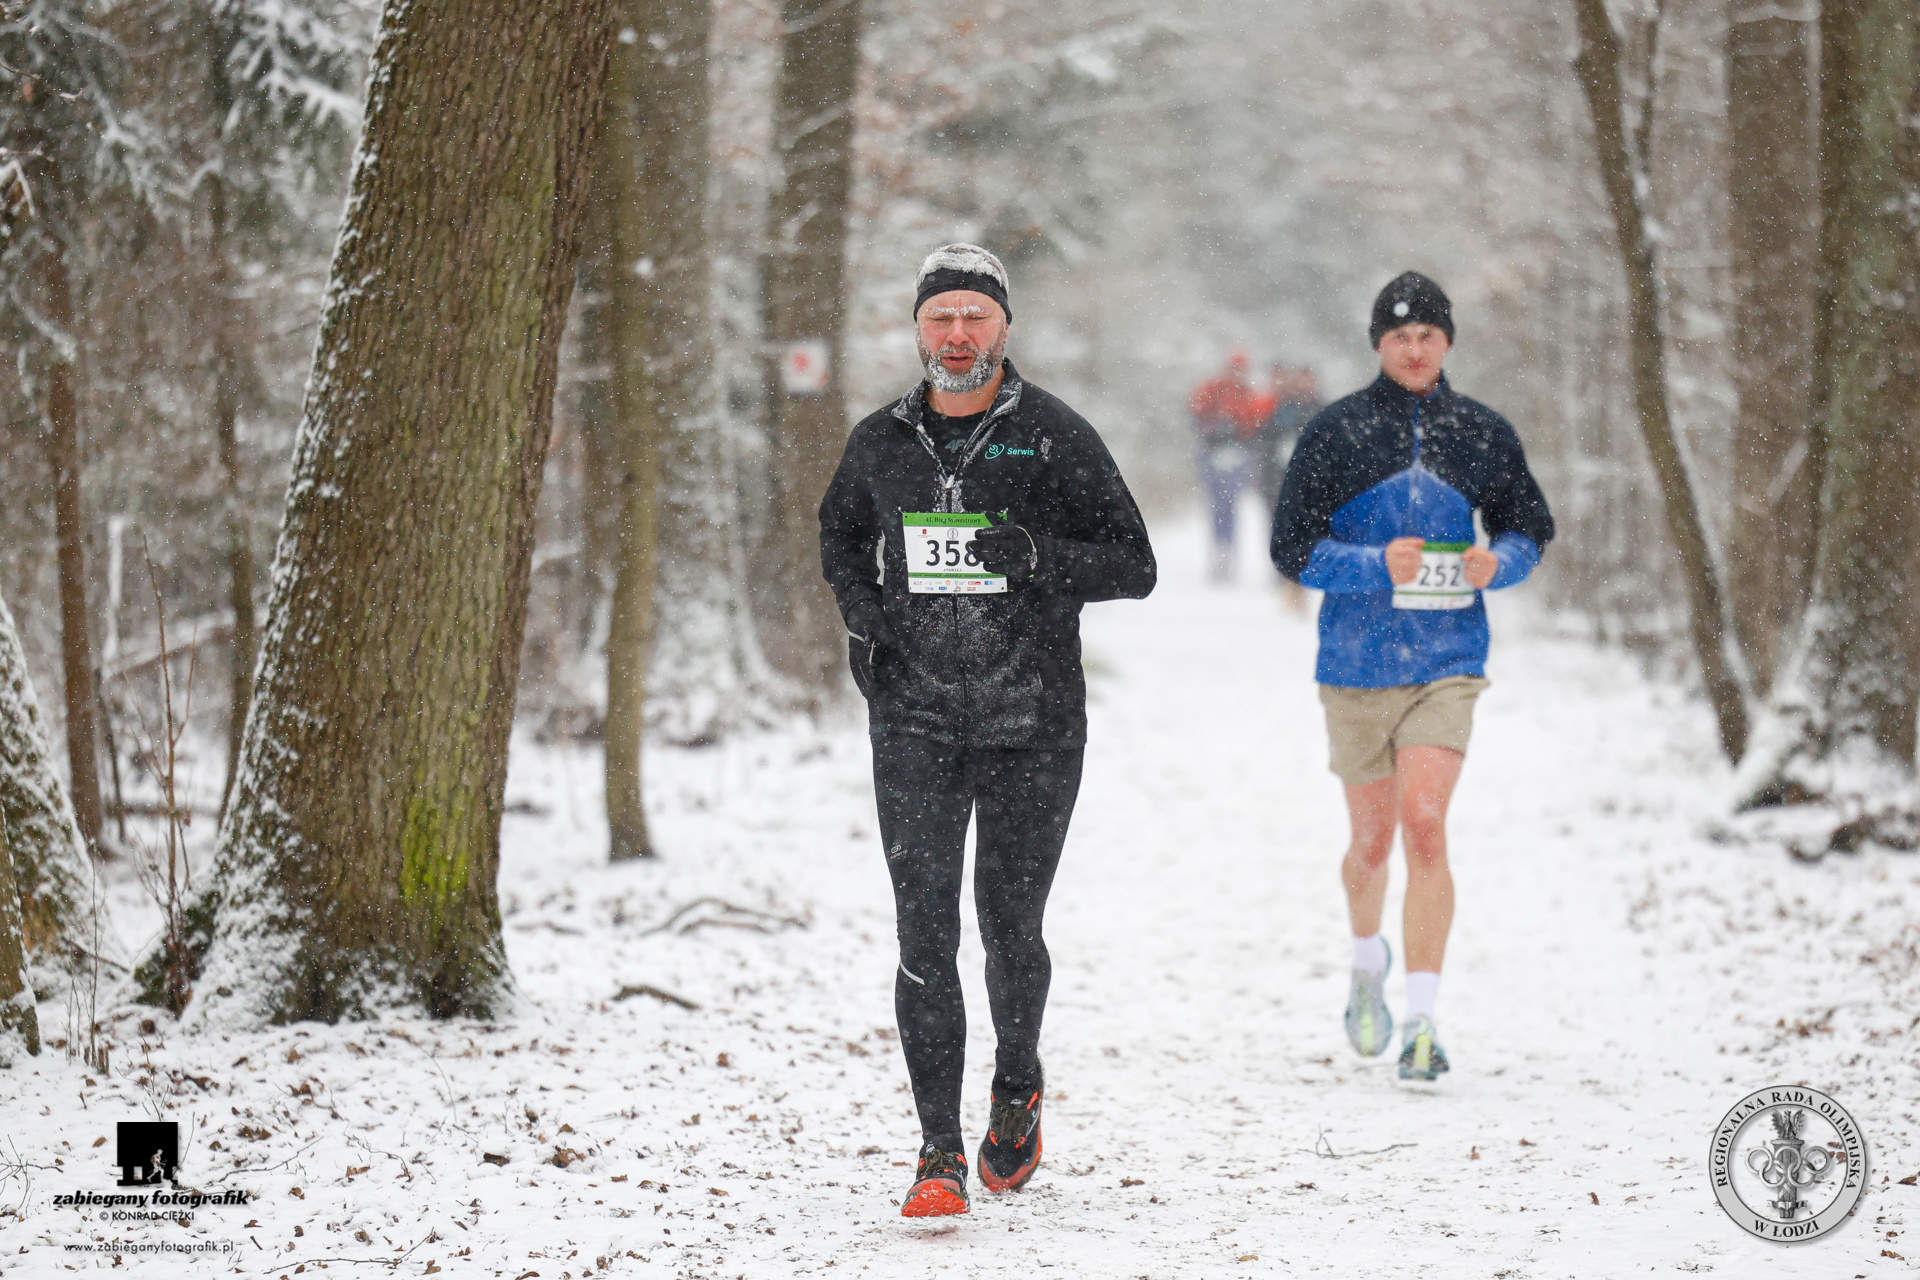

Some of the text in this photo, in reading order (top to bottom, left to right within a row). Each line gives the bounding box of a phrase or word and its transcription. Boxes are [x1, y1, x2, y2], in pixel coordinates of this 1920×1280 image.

[1007, 447, 1035, 456] Serwis
[926, 540, 980, 567] 358
[1419, 564, 1461, 587] 252
